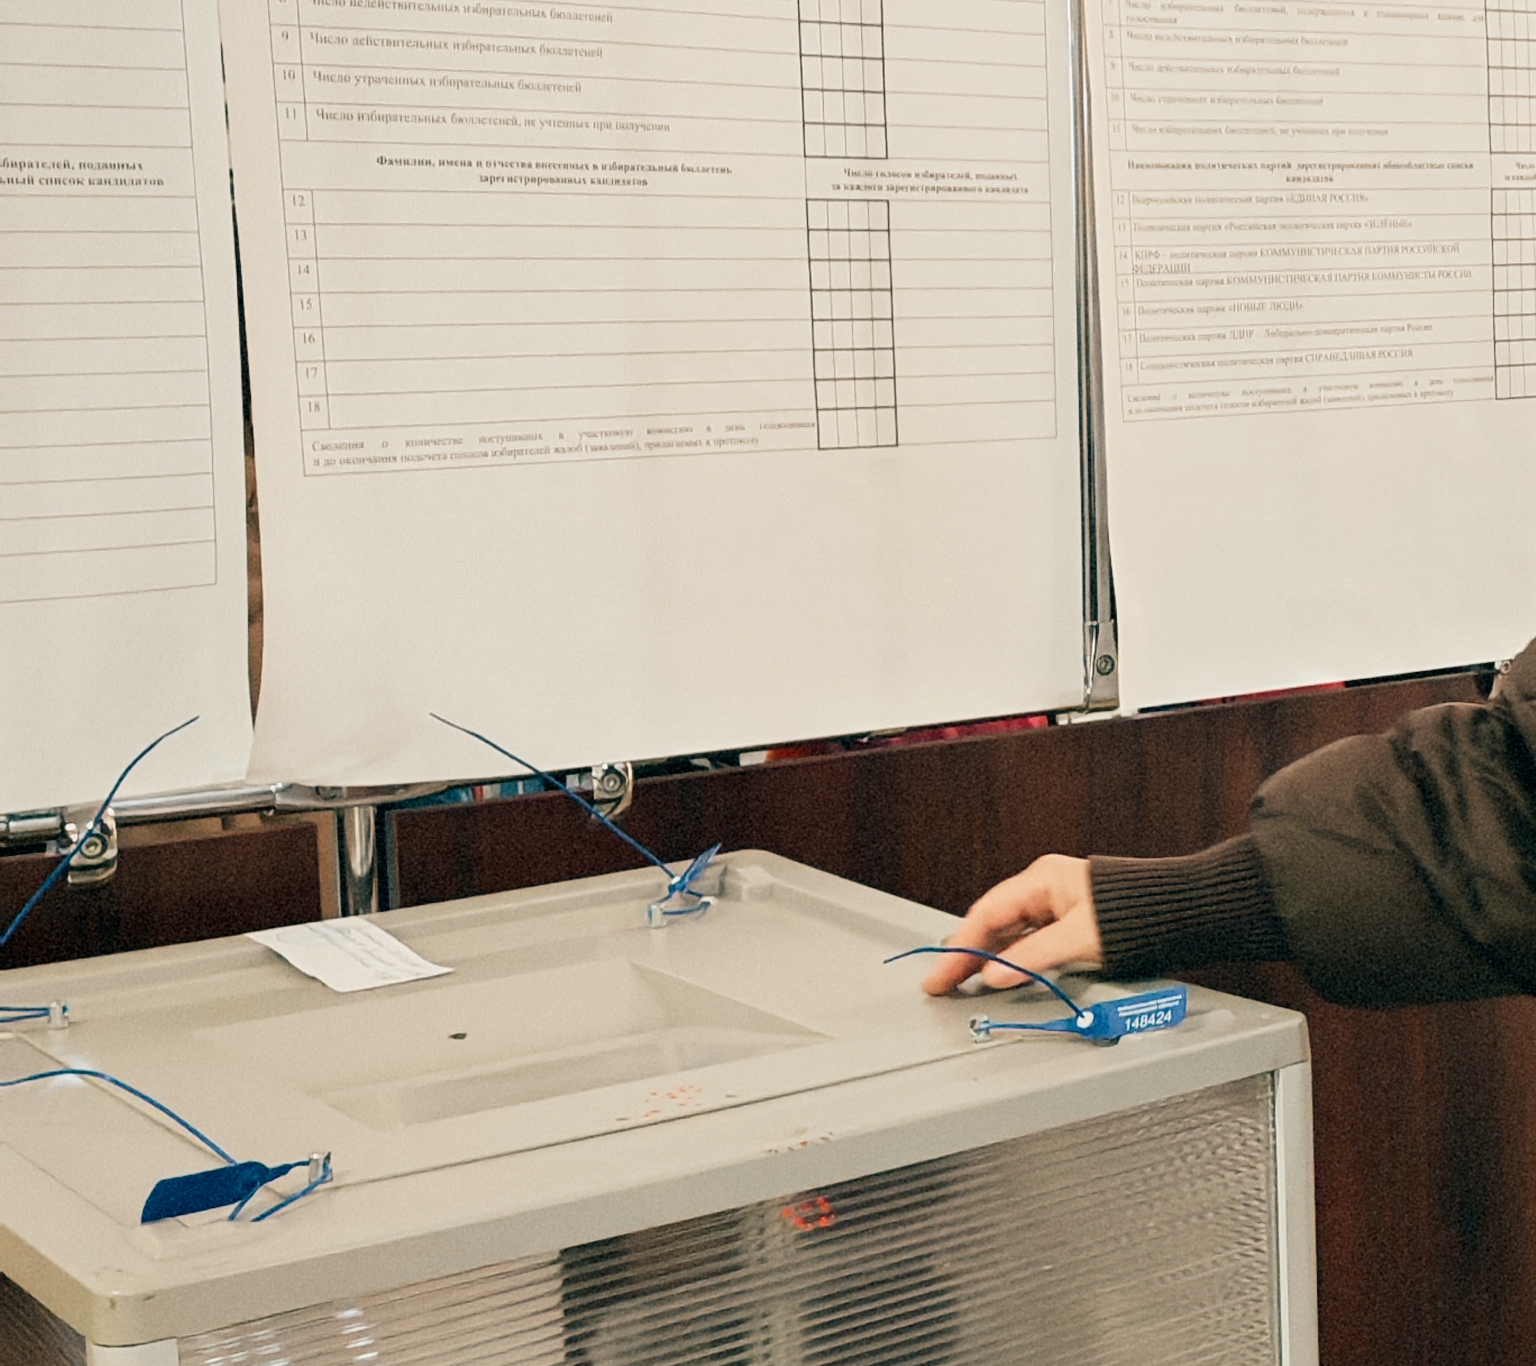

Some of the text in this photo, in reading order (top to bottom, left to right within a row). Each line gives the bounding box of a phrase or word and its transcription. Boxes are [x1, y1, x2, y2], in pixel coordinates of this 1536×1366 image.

[281, 31, 289, 42] 9
[283, 69, 296, 81] 10
[285, 107, 296, 120] 11
[0, 159, 143, 171] бирателей, поданных
[293, 194, 305, 207] 12
[295, 229, 307, 241] 13
[298, 264, 310, 275] 14
[300, 298, 312, 310] 15
[303, 332, 315, 344] 16
[306, 367, 318, 378] 17
[308, 401, 320, 412] 18
[1125, 1009, 1173, 1032] 148424
